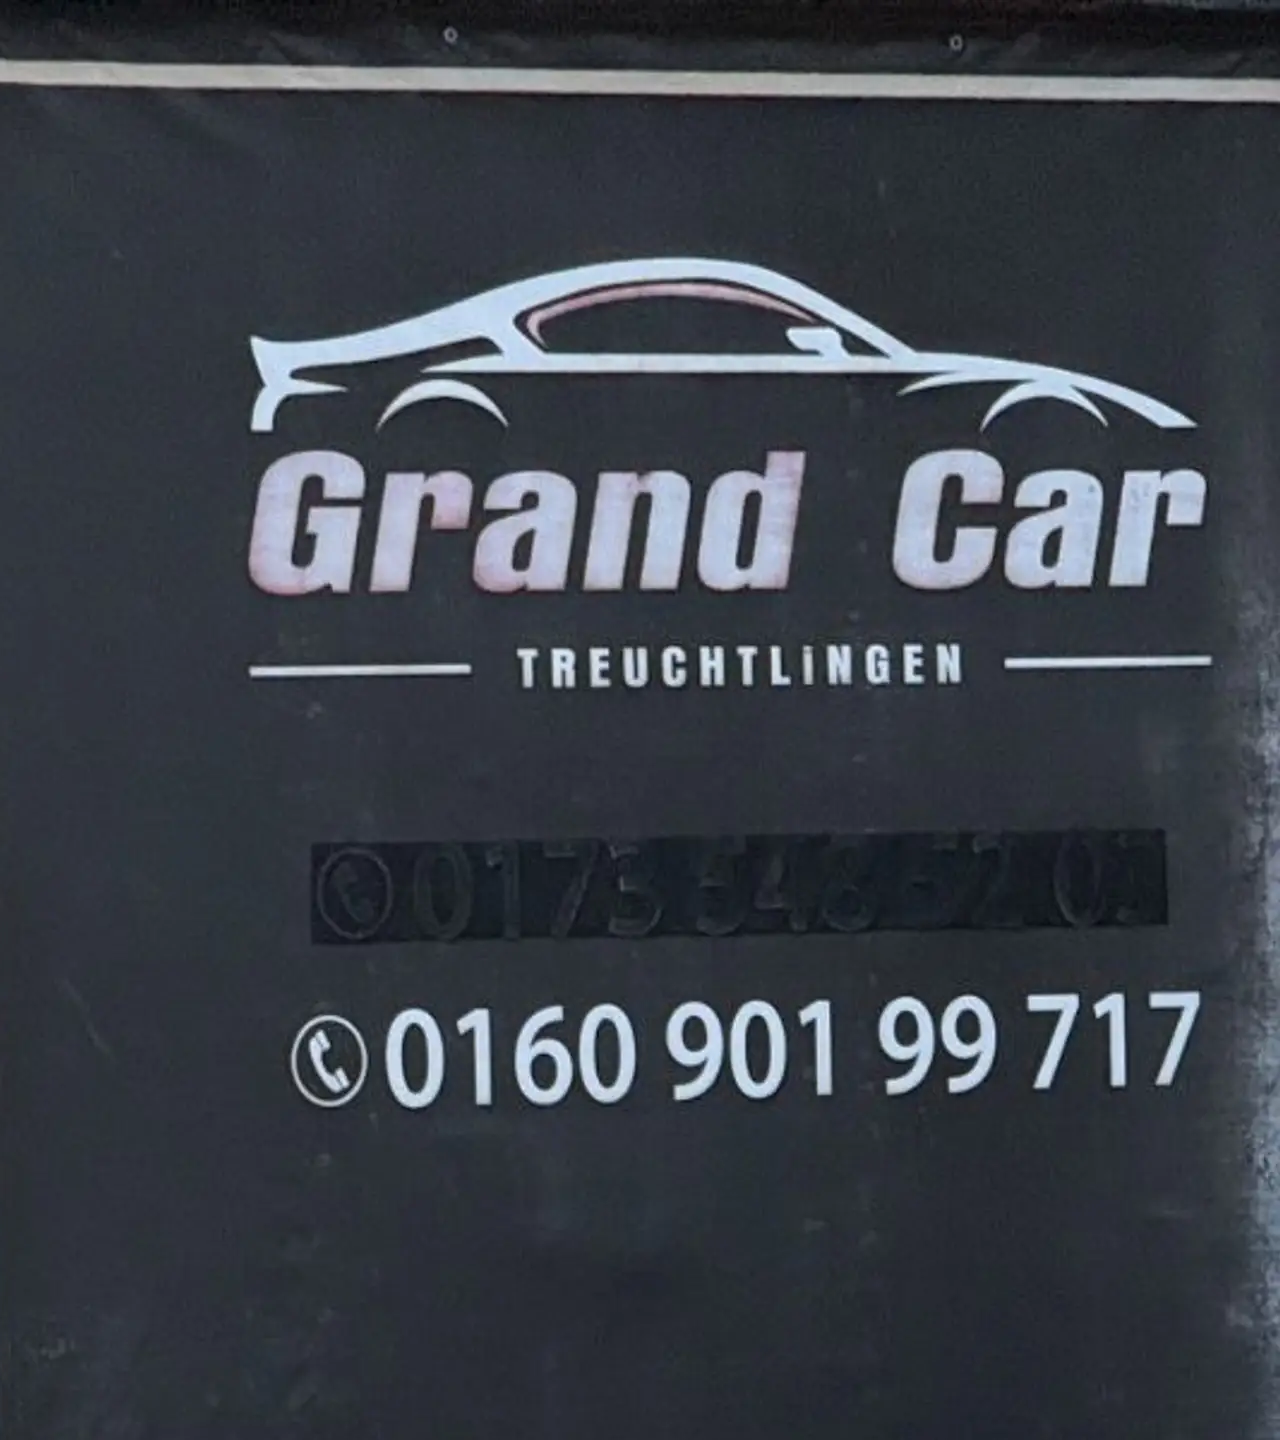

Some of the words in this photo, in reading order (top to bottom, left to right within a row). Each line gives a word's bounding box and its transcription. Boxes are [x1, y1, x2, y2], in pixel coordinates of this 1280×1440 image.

[248, 450, 805, 594] Grand
[892, 449, 1208, 589] Car
[385, 1003, 636, 1108] 0160
[666, 1000, 832, 1101] 901
[878, 995, 996, 1095] 99
[1027, 991, 1201, 1089] 717
